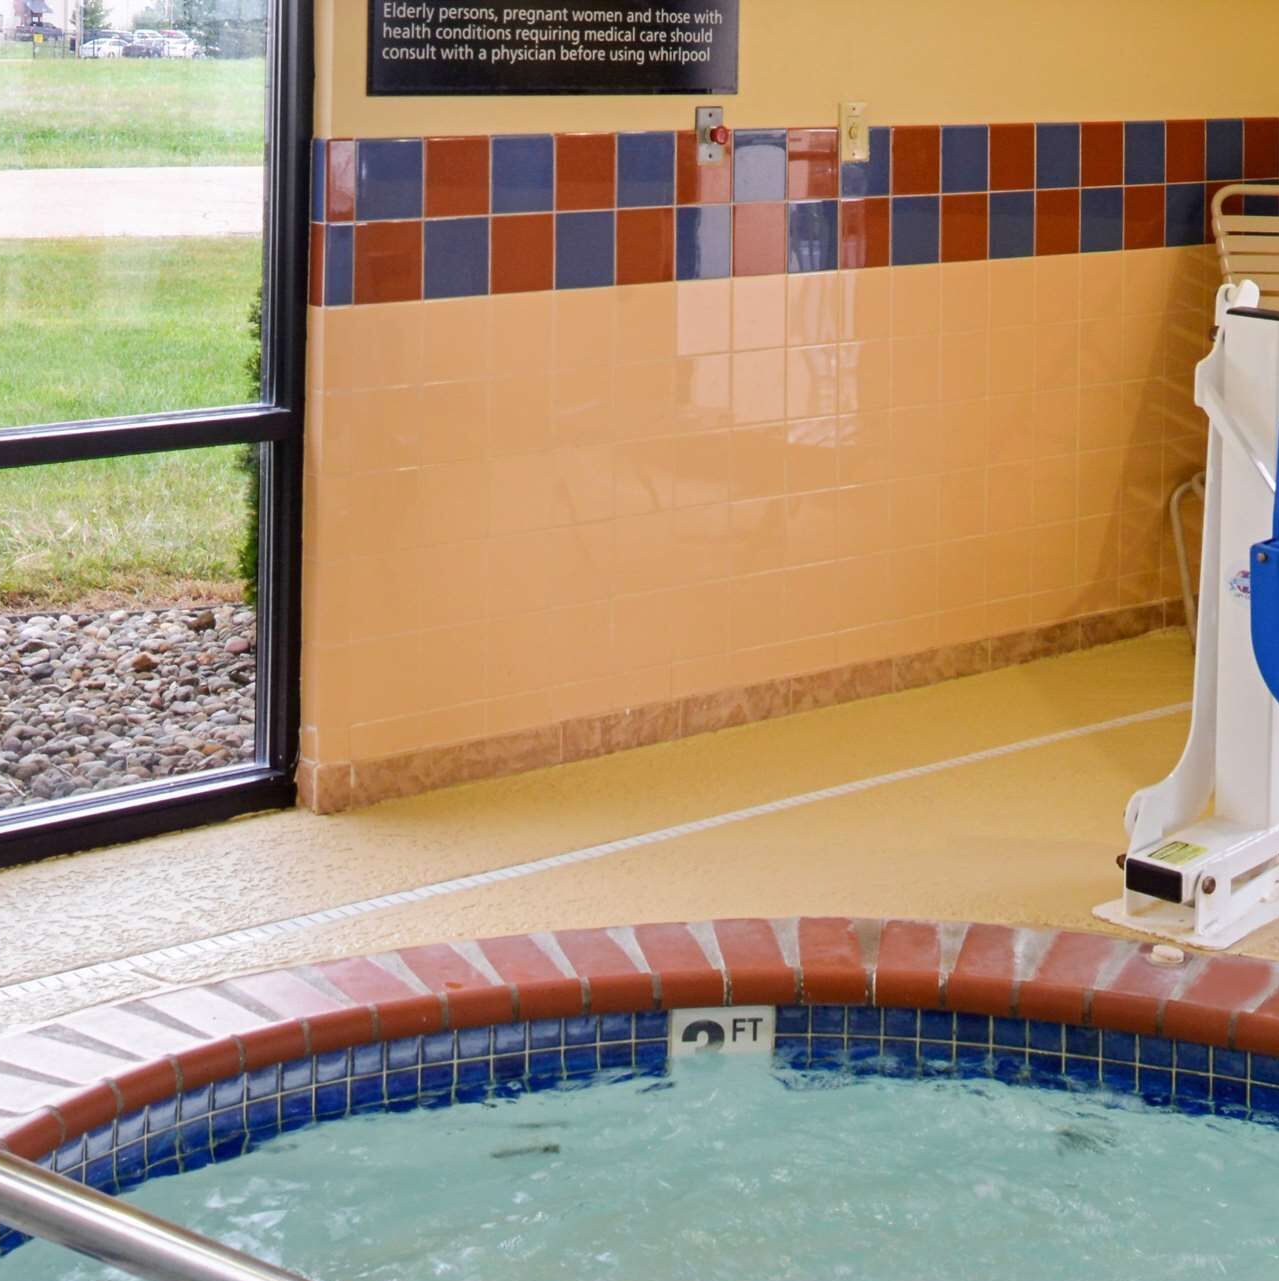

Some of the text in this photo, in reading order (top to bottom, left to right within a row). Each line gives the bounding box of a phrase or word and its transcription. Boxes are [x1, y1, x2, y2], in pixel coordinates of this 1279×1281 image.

[383, 2, 723, 24] Elderly persons, pregnant women and those with
[383, 23, 713, 44] health conditions requiring medical care should
[382, 44, 711, 65] consult with a physician before using whirlpool
[732, 1017, 763, 1042] FT
